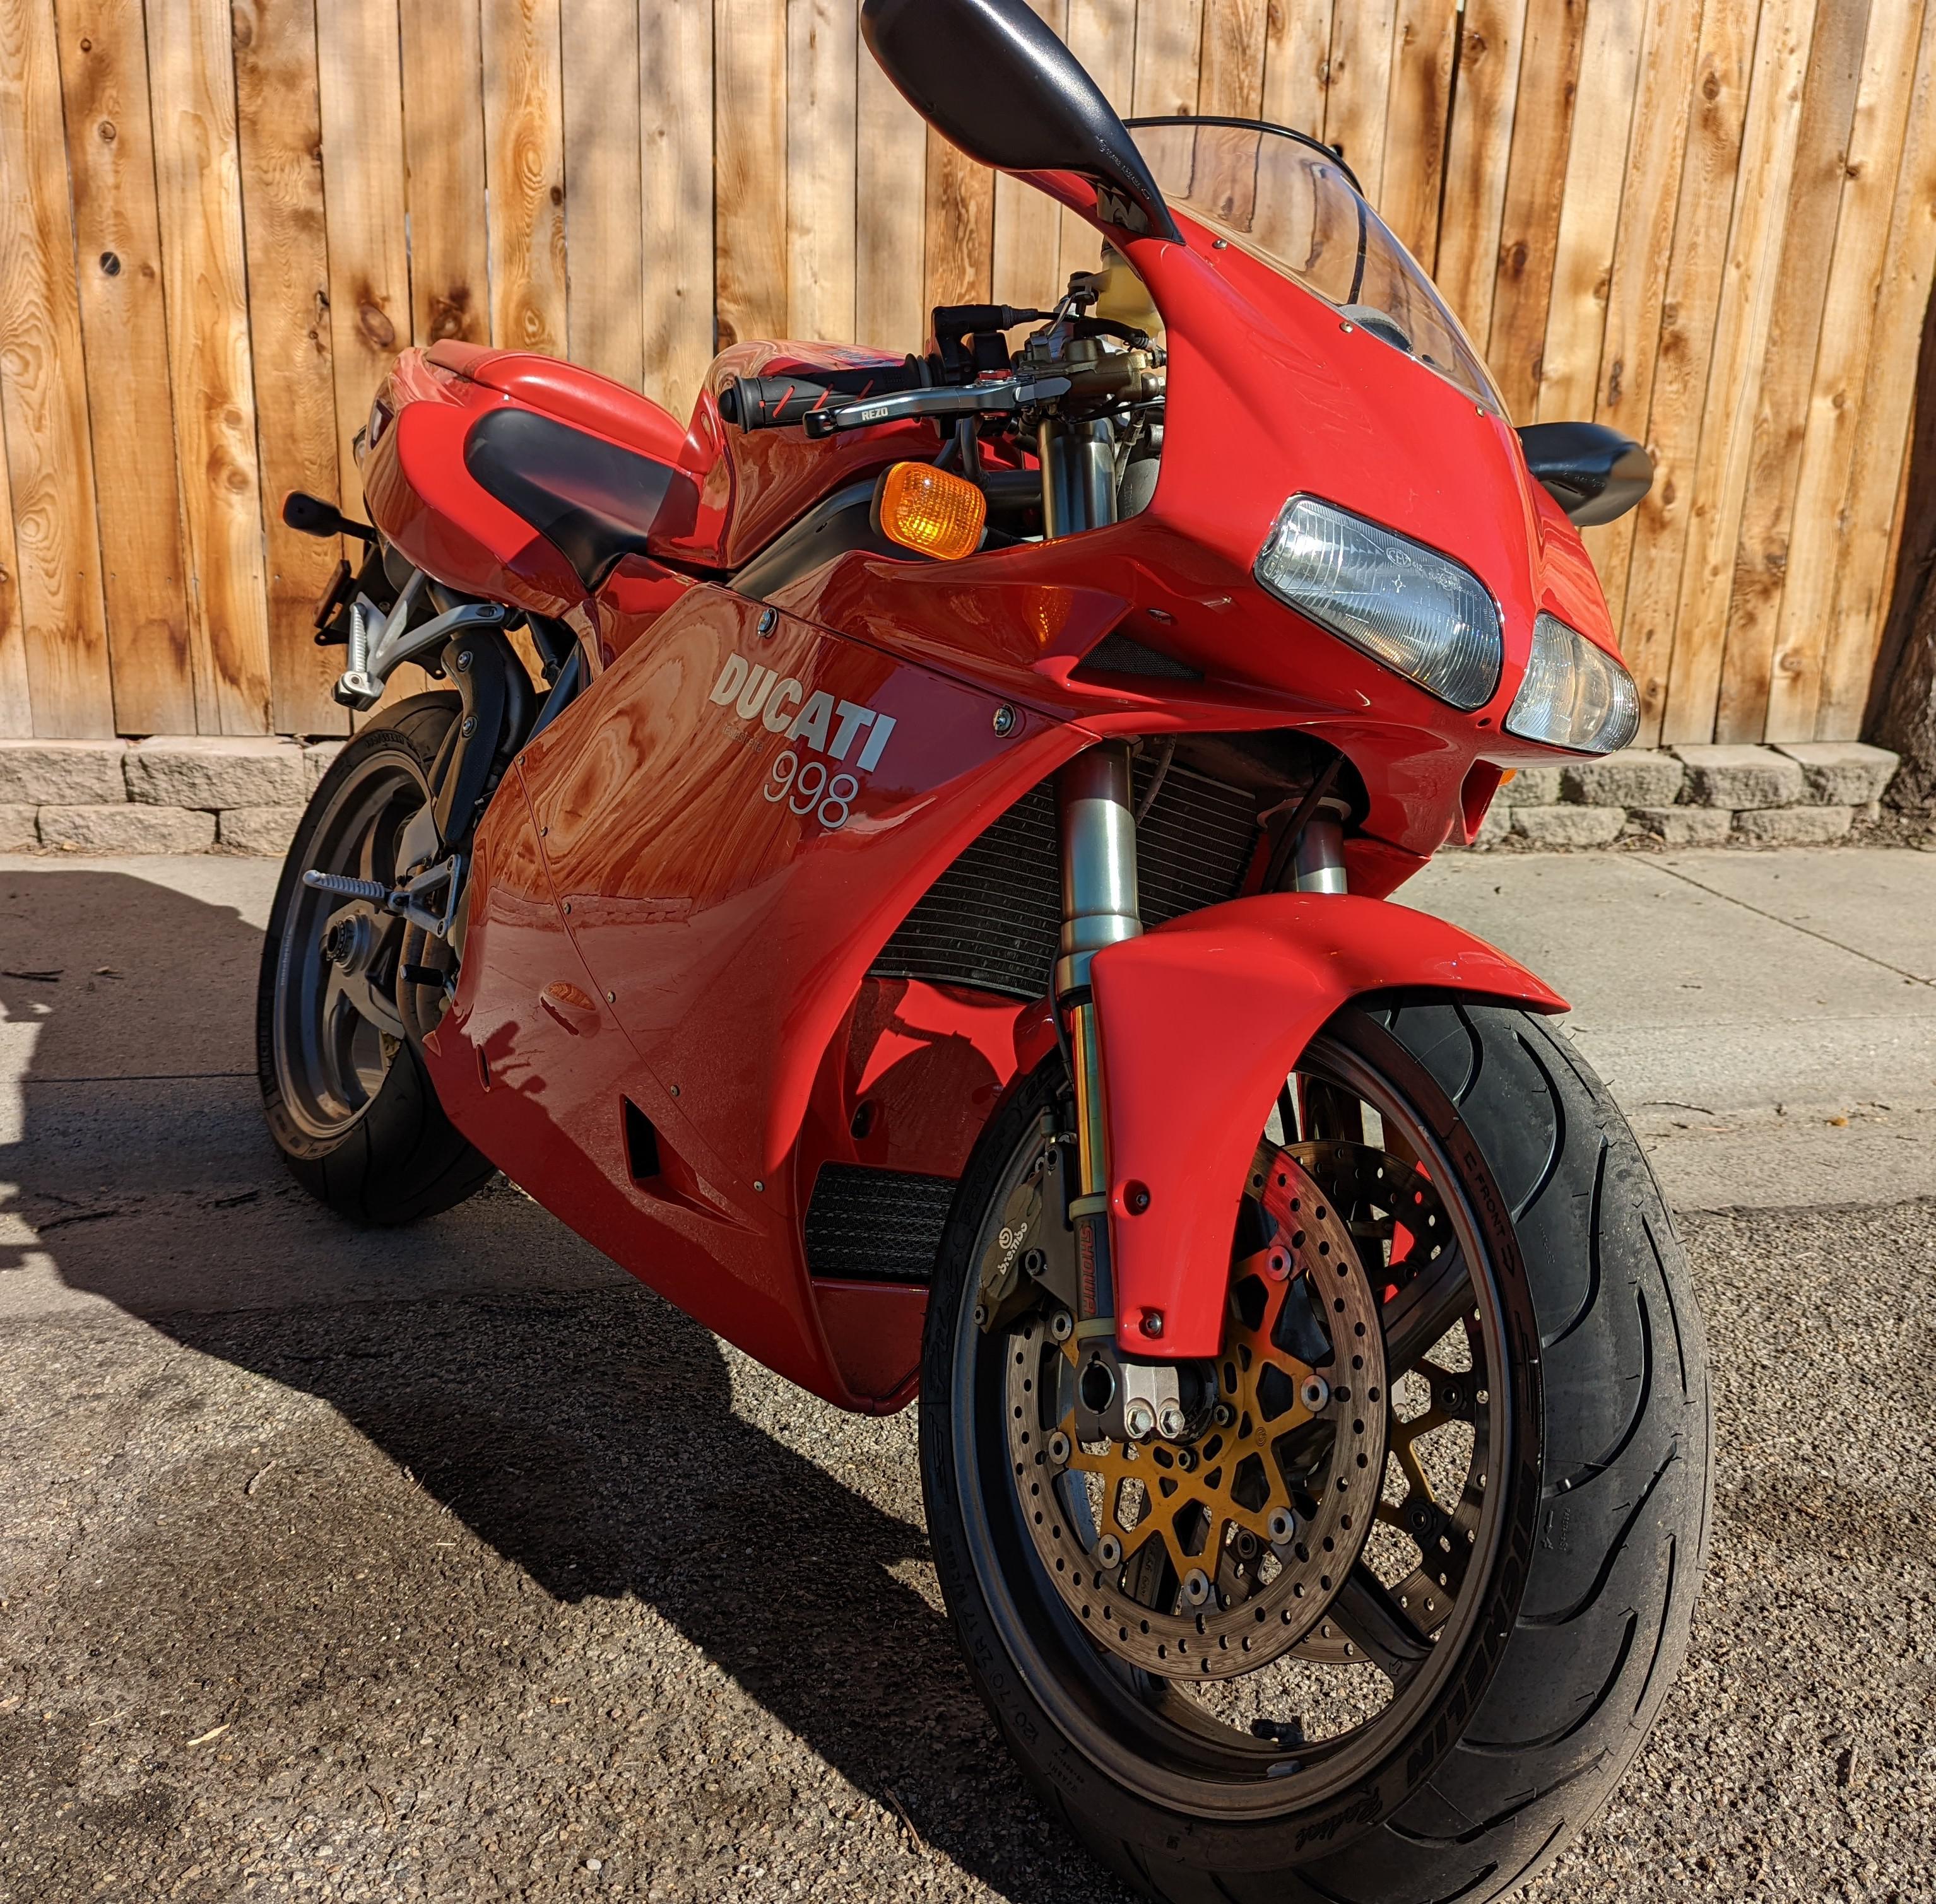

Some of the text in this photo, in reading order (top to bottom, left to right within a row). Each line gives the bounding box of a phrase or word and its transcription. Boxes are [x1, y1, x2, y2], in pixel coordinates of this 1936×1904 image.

[861, 407, 888, 421] REZO
[1388, 549, 1409, 566] CEV
[709, 652, 897, 772] DUCATI
[764, 750, 858, 828] 998
[1474, 1172, 1506, 1237] FRONT
[998, 1222, 1028, 1275] brembo
[1080, 1225, 1097, 1315] SHOWA
[975, 1639, 993, 1668] ZR
[1407, 1459, 1537, 1788] MICHELIN
[1294, 1787, 1384, 1852] Radial
